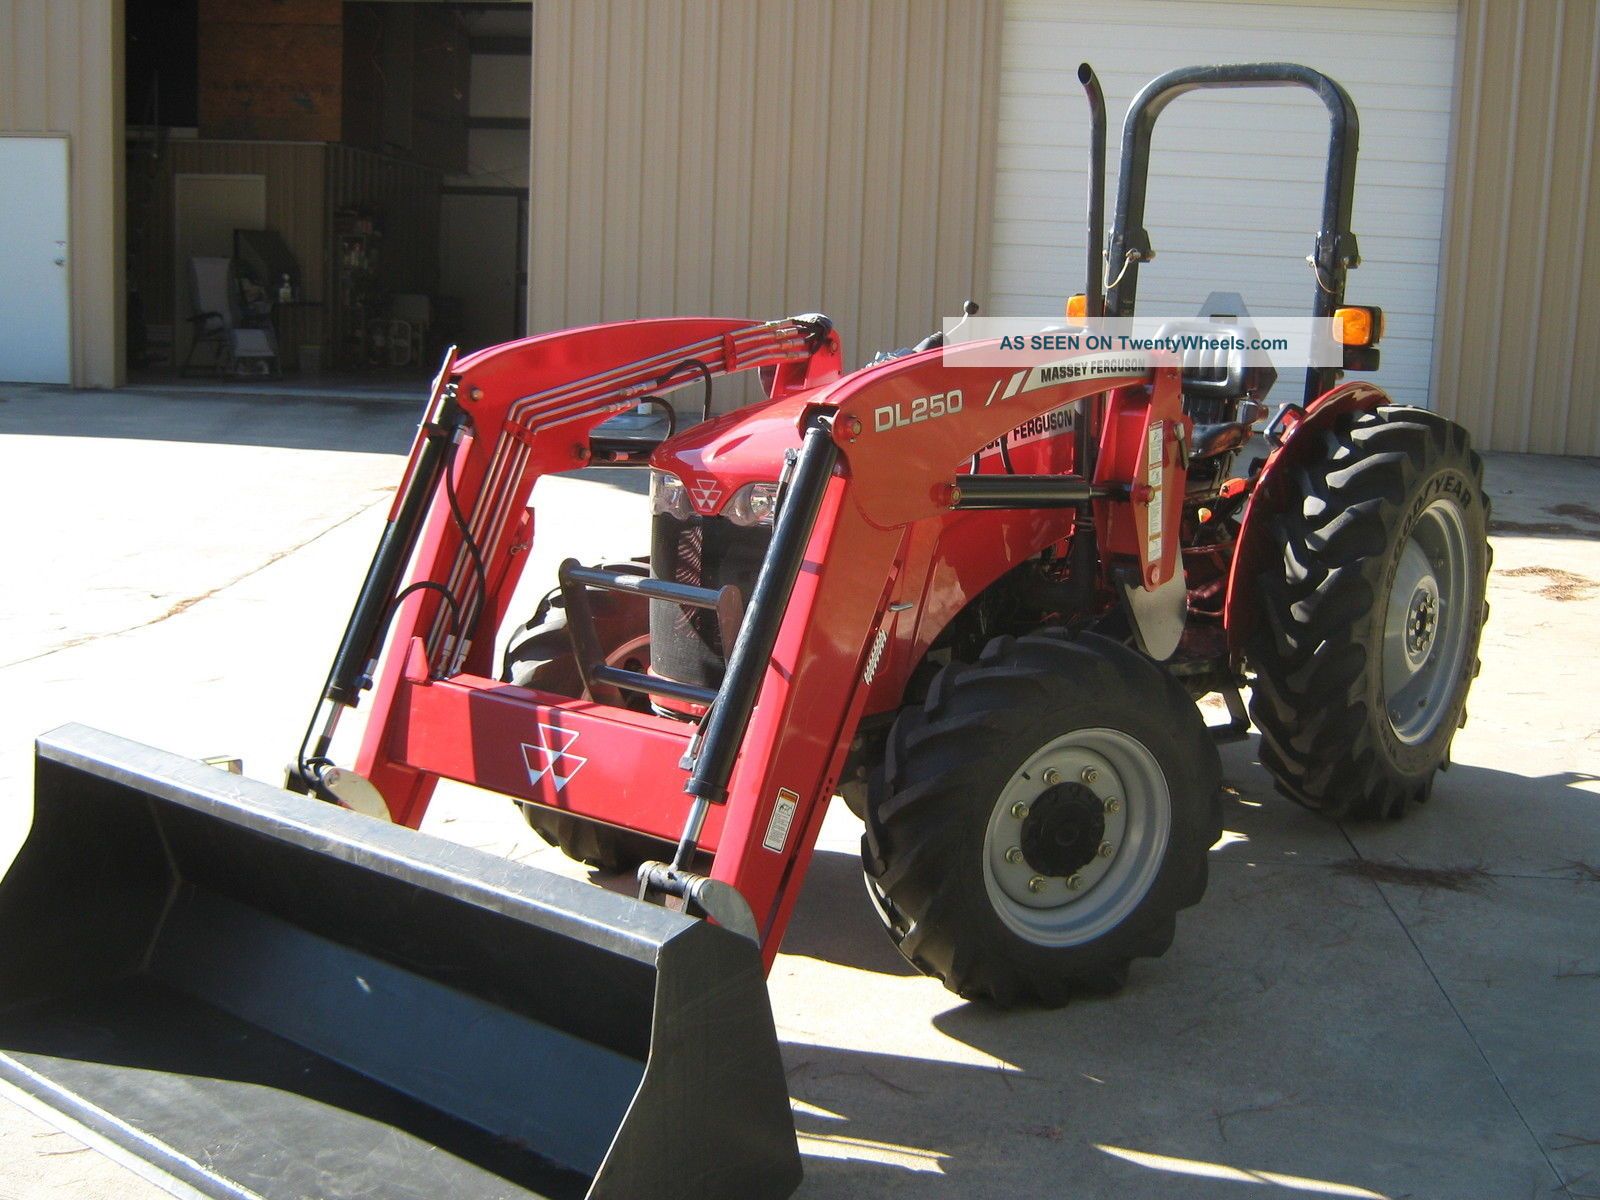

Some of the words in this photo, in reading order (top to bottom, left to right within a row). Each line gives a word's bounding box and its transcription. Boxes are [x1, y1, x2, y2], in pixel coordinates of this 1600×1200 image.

[1040, 361, 1088, 383] MASSEY
[1090, 358, 1146, 375] FERGUSON
[874, 389, 963, 432] DL250
[1012, 409, 1073, 441] FERGUSON
